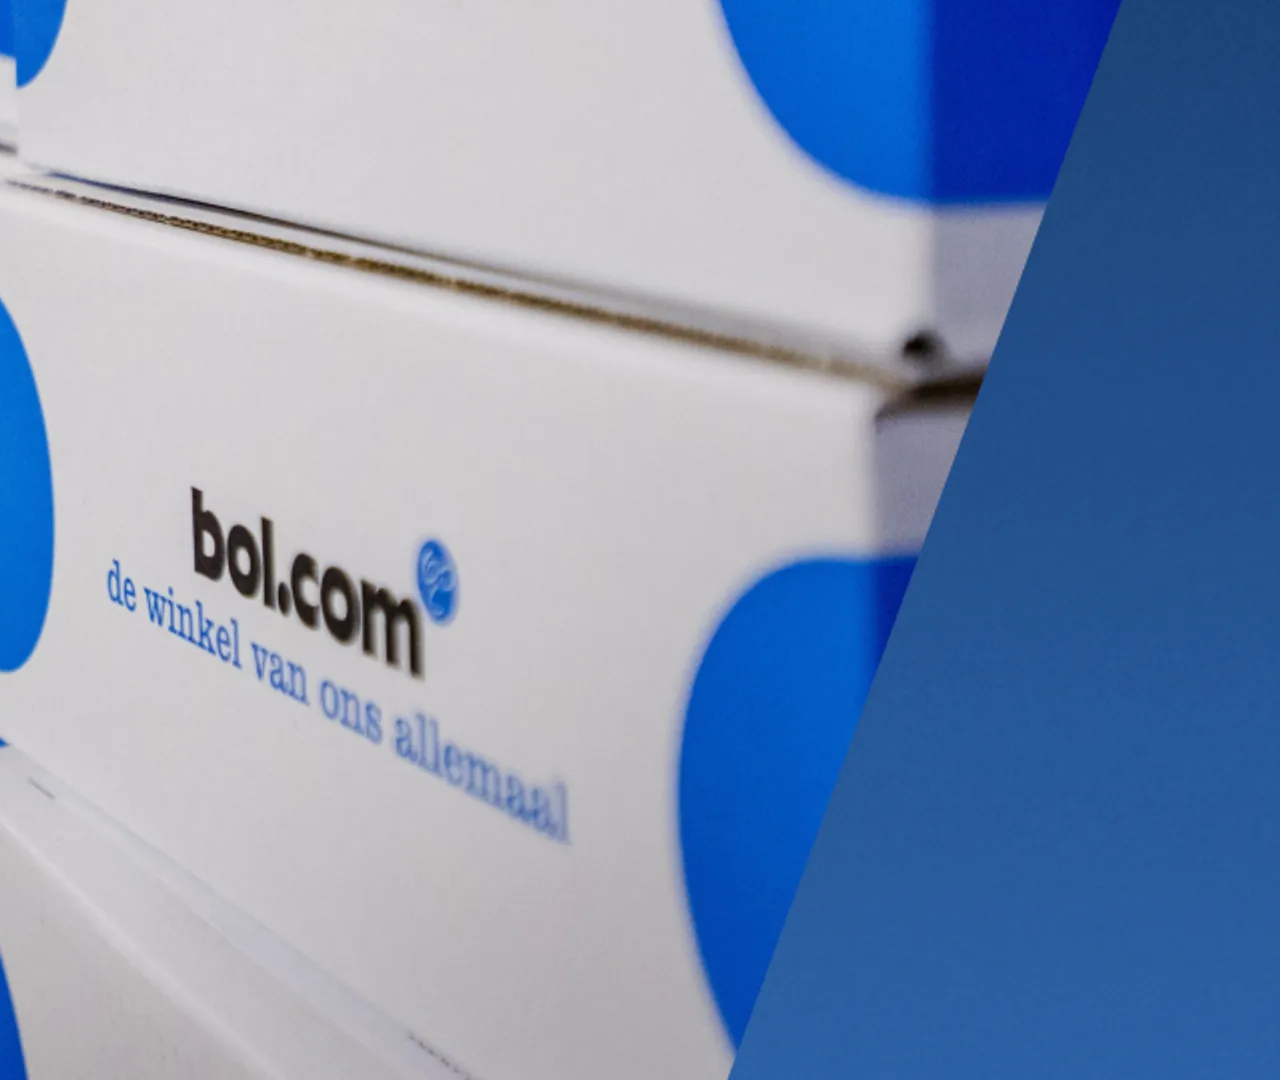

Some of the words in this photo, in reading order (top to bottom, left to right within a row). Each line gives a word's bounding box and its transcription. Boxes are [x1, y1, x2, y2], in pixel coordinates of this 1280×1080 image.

[106, 558, 137, 613] de
[143, 586, 242, 669] winkel
[249, 641, 310, 706] van
[318, 678, 383, 744] ons
[392, 712, 572, 845] allemaal
[190, 485, 425, 680] bol.com
